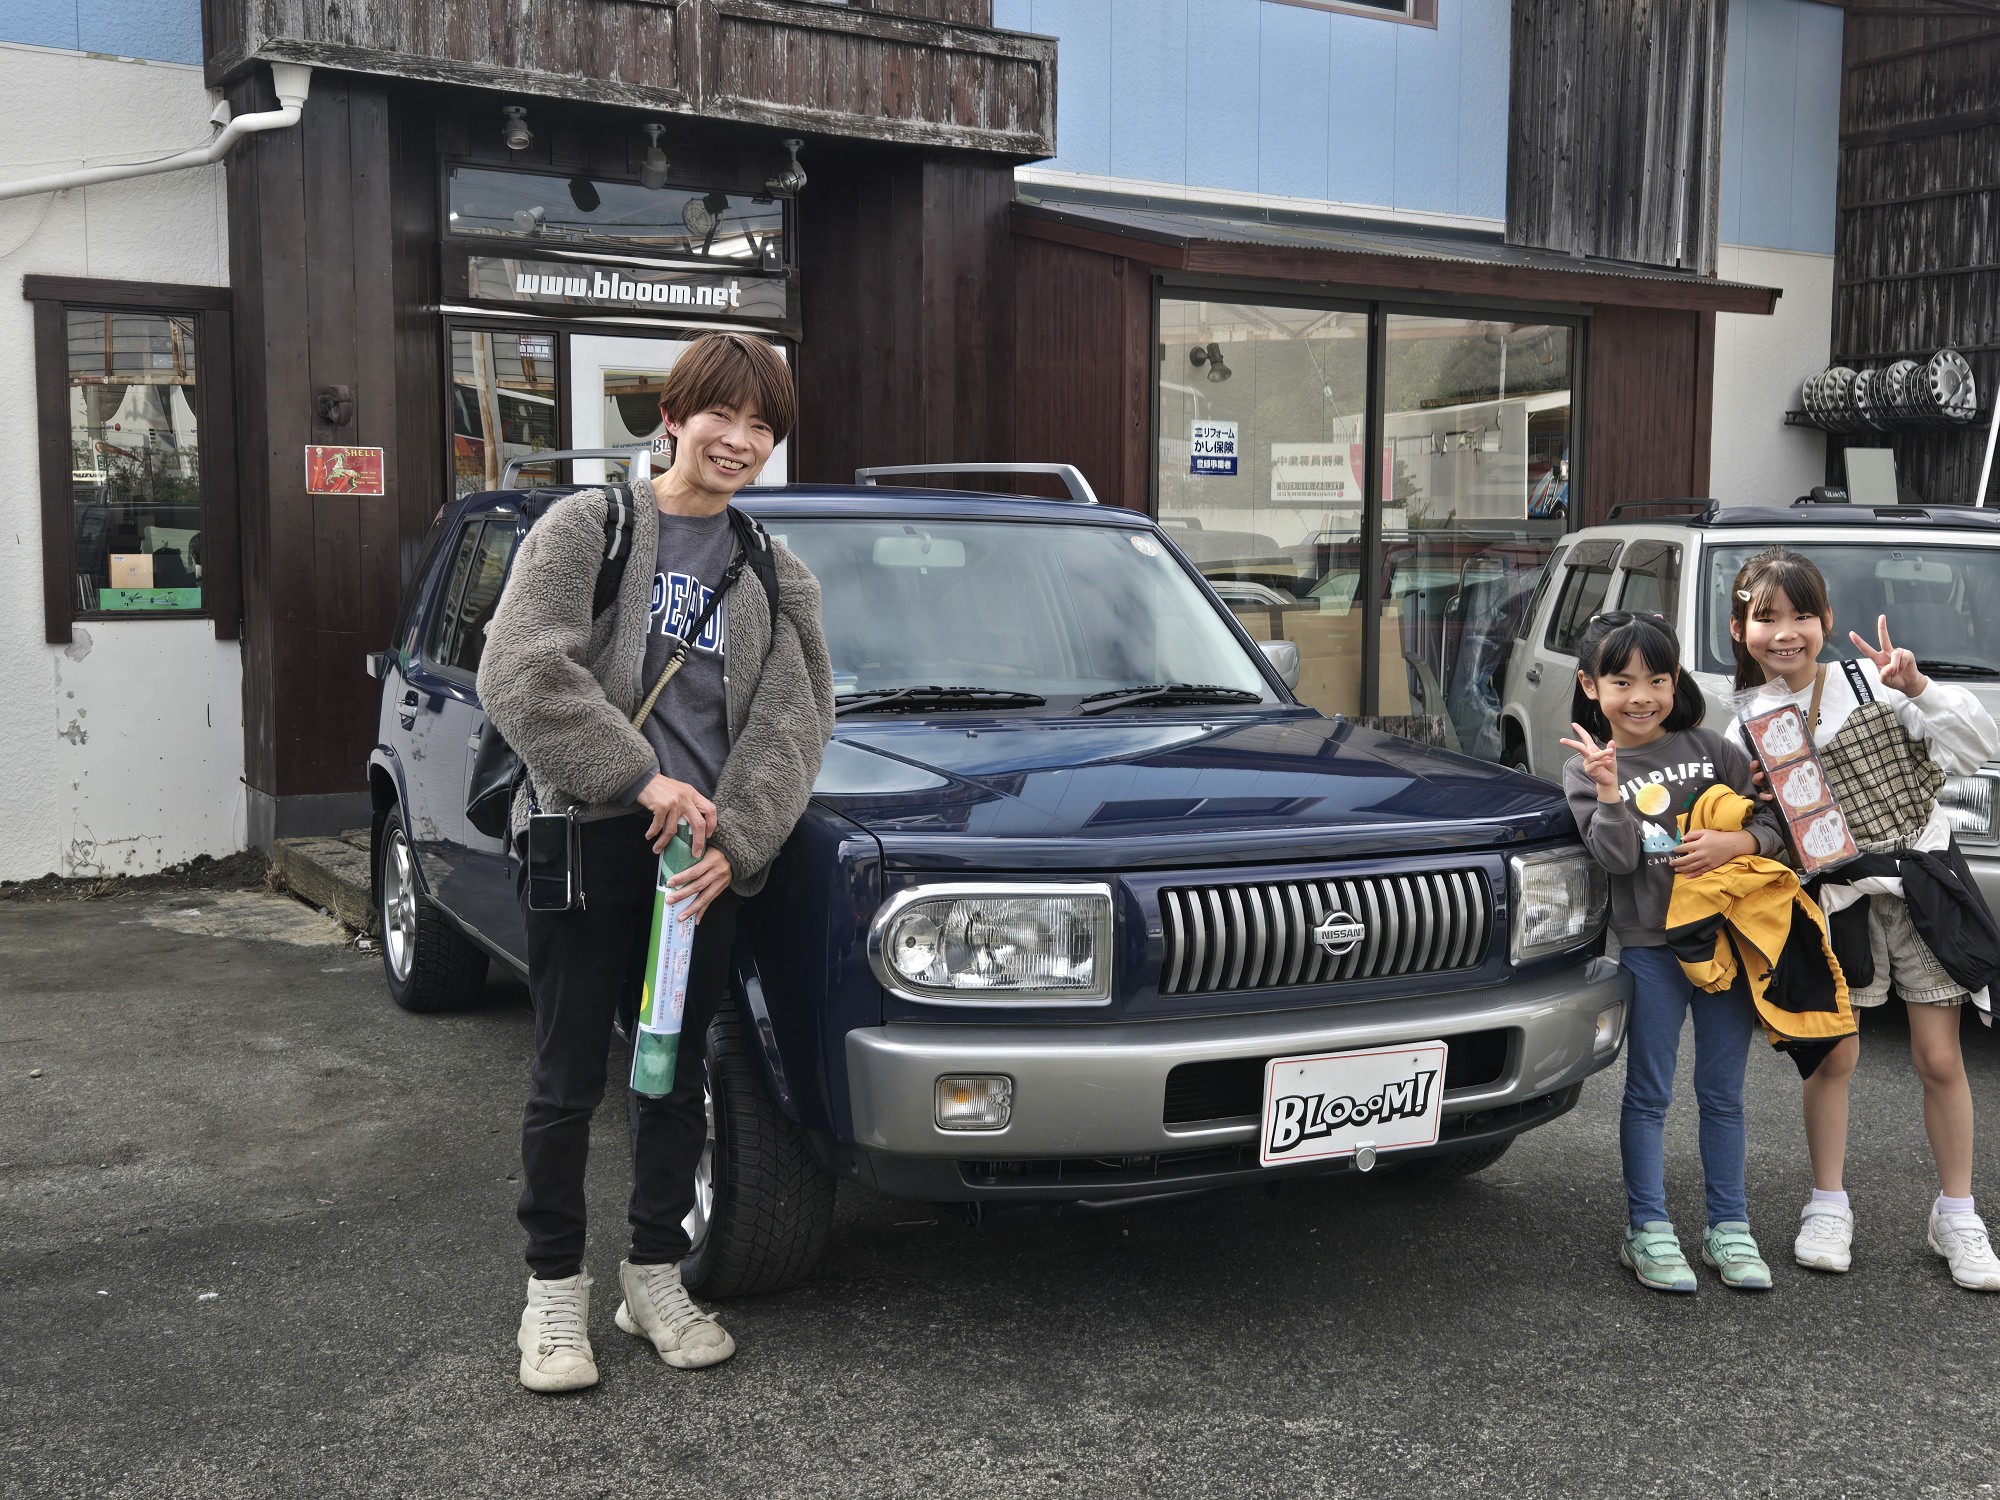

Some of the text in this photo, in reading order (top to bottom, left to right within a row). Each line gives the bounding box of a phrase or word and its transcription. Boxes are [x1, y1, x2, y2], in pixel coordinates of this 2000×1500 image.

[516, 271, 742, 307] www.blooom.net
[1204, 427, 1235, 439] リフォーム
[344, 448, 376, 457] SHELL
[1194, 440, 1234, 454] かし保険
[1321, 928, 1361, 940] NISSAN
